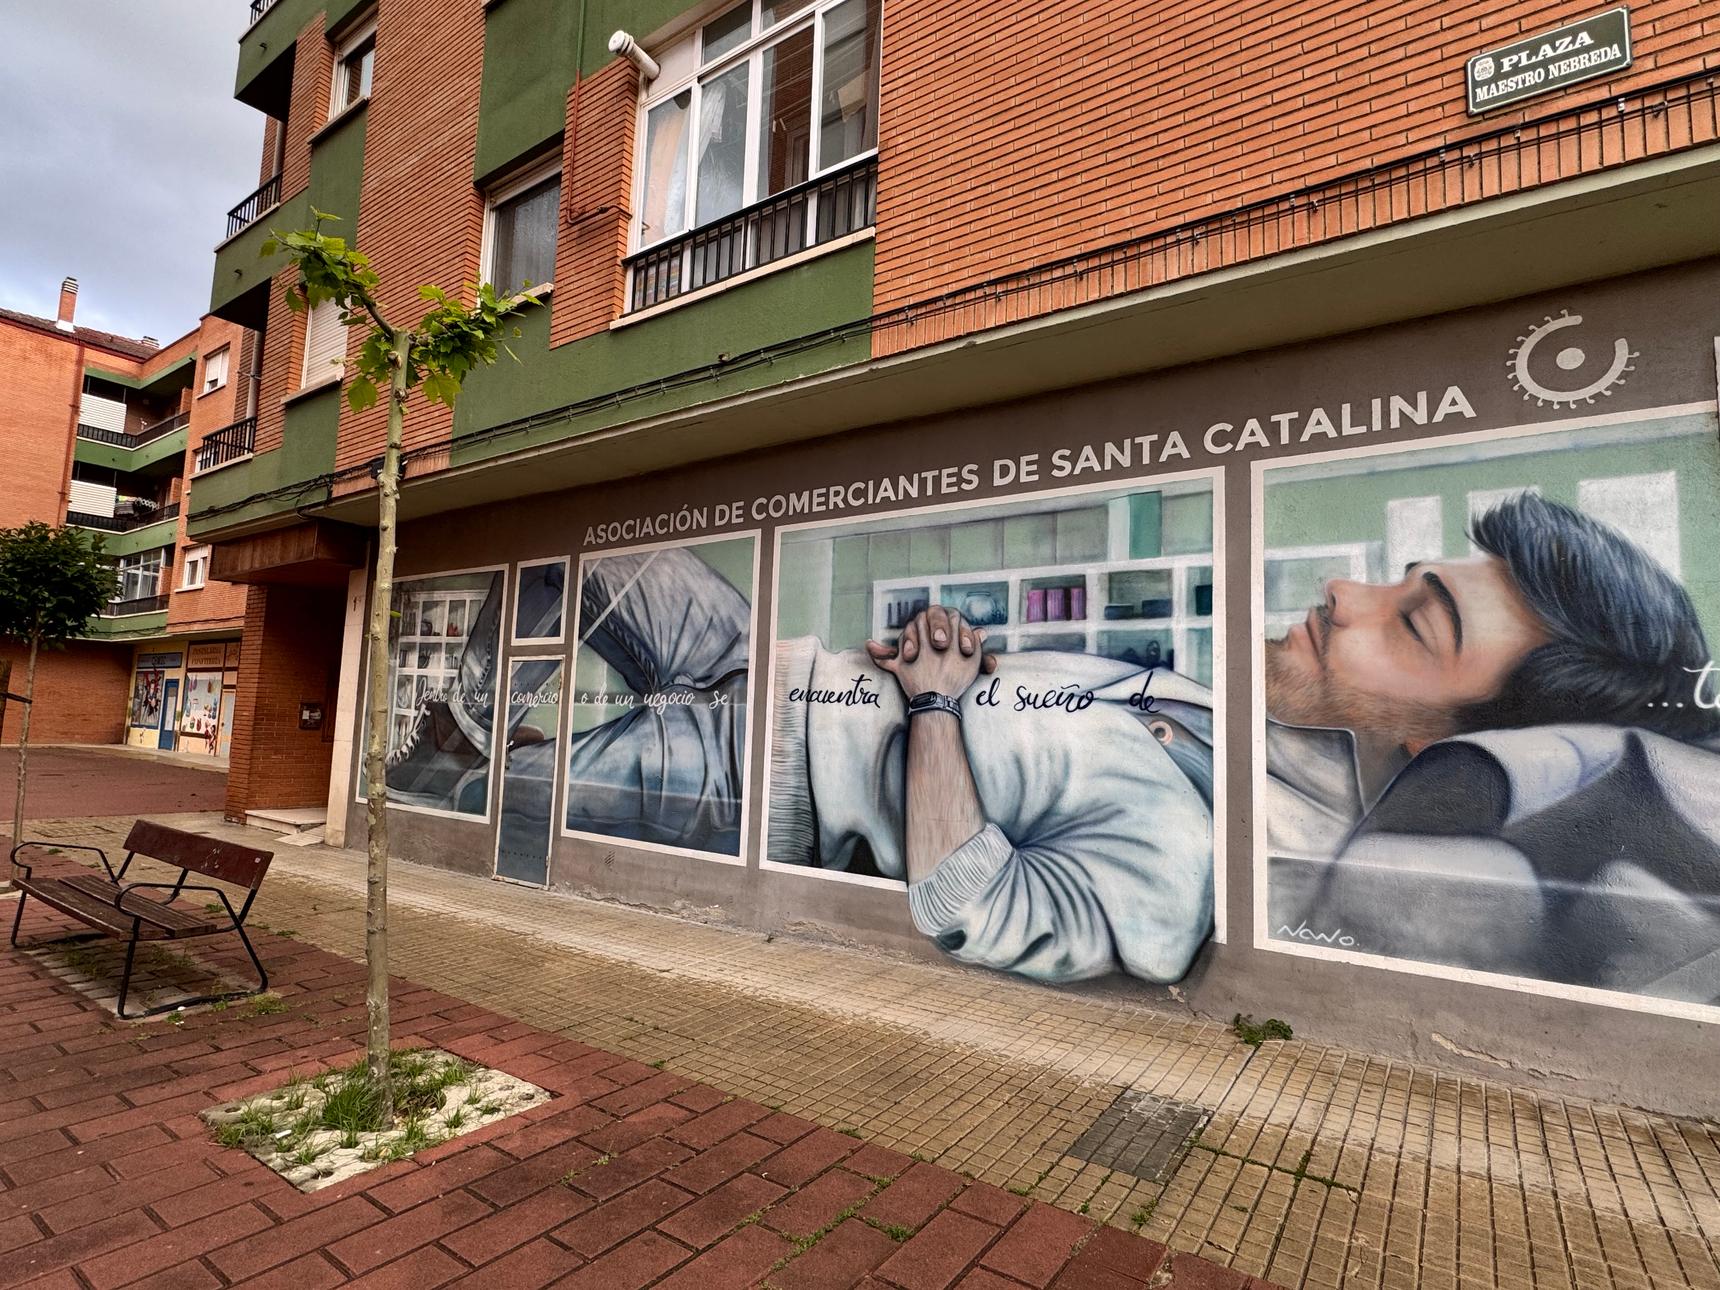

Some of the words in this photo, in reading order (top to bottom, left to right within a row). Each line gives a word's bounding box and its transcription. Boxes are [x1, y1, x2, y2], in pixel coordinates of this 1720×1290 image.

[1475, 69, 1545, 103] MAESTRO
[1548, 43, 1622, 80] NEBREDA
[1500, 31, 1595, 73] PLAZA
[583, 504, 708, 546] ASOCIACIÓN
[714, 501, 745, 527] DE
[751, 463, 979, 518] COMERCIANTES
[993, 453, 1039, 487] DE
[1051, 430, 1191, 477] SANTA
[1203, 385, 1477, 454] CATALINA
[453, 683, 466, 704] de
[474, 689, 489, 709] un
[511, 690, 559, 708] comercio
[594, 681, 609, 704] de
[615, 692, 635, 710] un
[643, 690, 696, 716] negocio
[789, 674, 881, 709] encuentra
[976, 677, 999, 707] el
[1015, 684, 1097, 713] sueño
[1129, 671, 1162, 713] de
